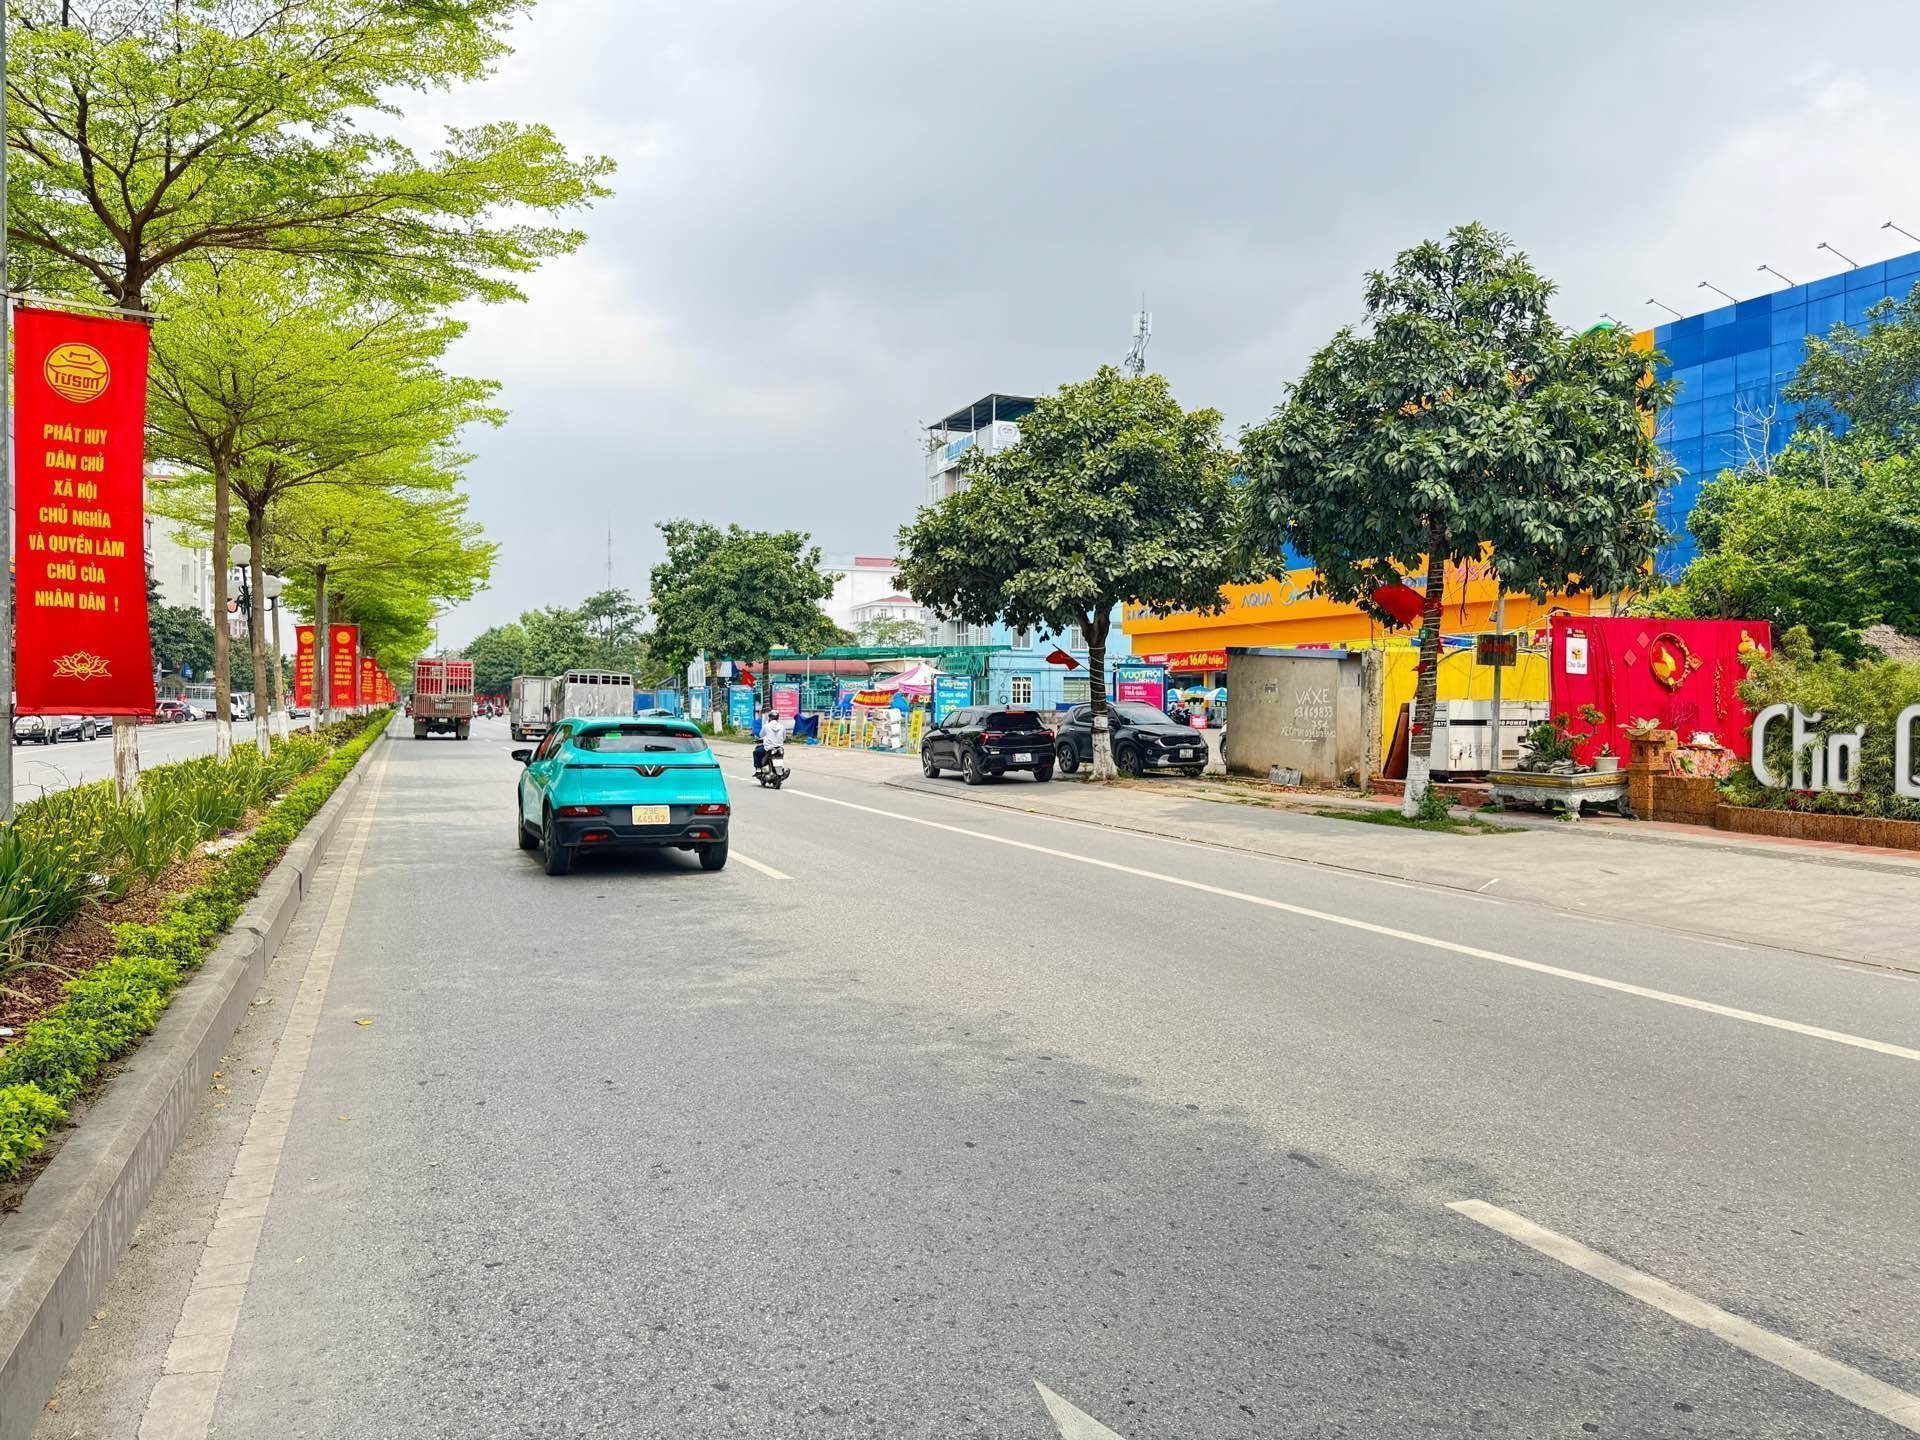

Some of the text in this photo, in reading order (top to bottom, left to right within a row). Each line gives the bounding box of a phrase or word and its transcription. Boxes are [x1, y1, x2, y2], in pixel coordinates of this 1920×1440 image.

[43, 424, 107, 445] PHÁT HUY
[45, 450, 104, 472] DÂN CHỦ
[53, 477, 97, 503] XÃ HỘI
[39, 503, 111, 528] CHỦ NGHĨA
[29, 531, 125, 557] VÀ QUYỀN LÀM
[47, 560, 106, 583] CHỦ CỦA
[35, 588, 75, 608] NHÂN
[79, 592, 106, 611] DÂN
[1241, 592, 1273, 608] AQUA
